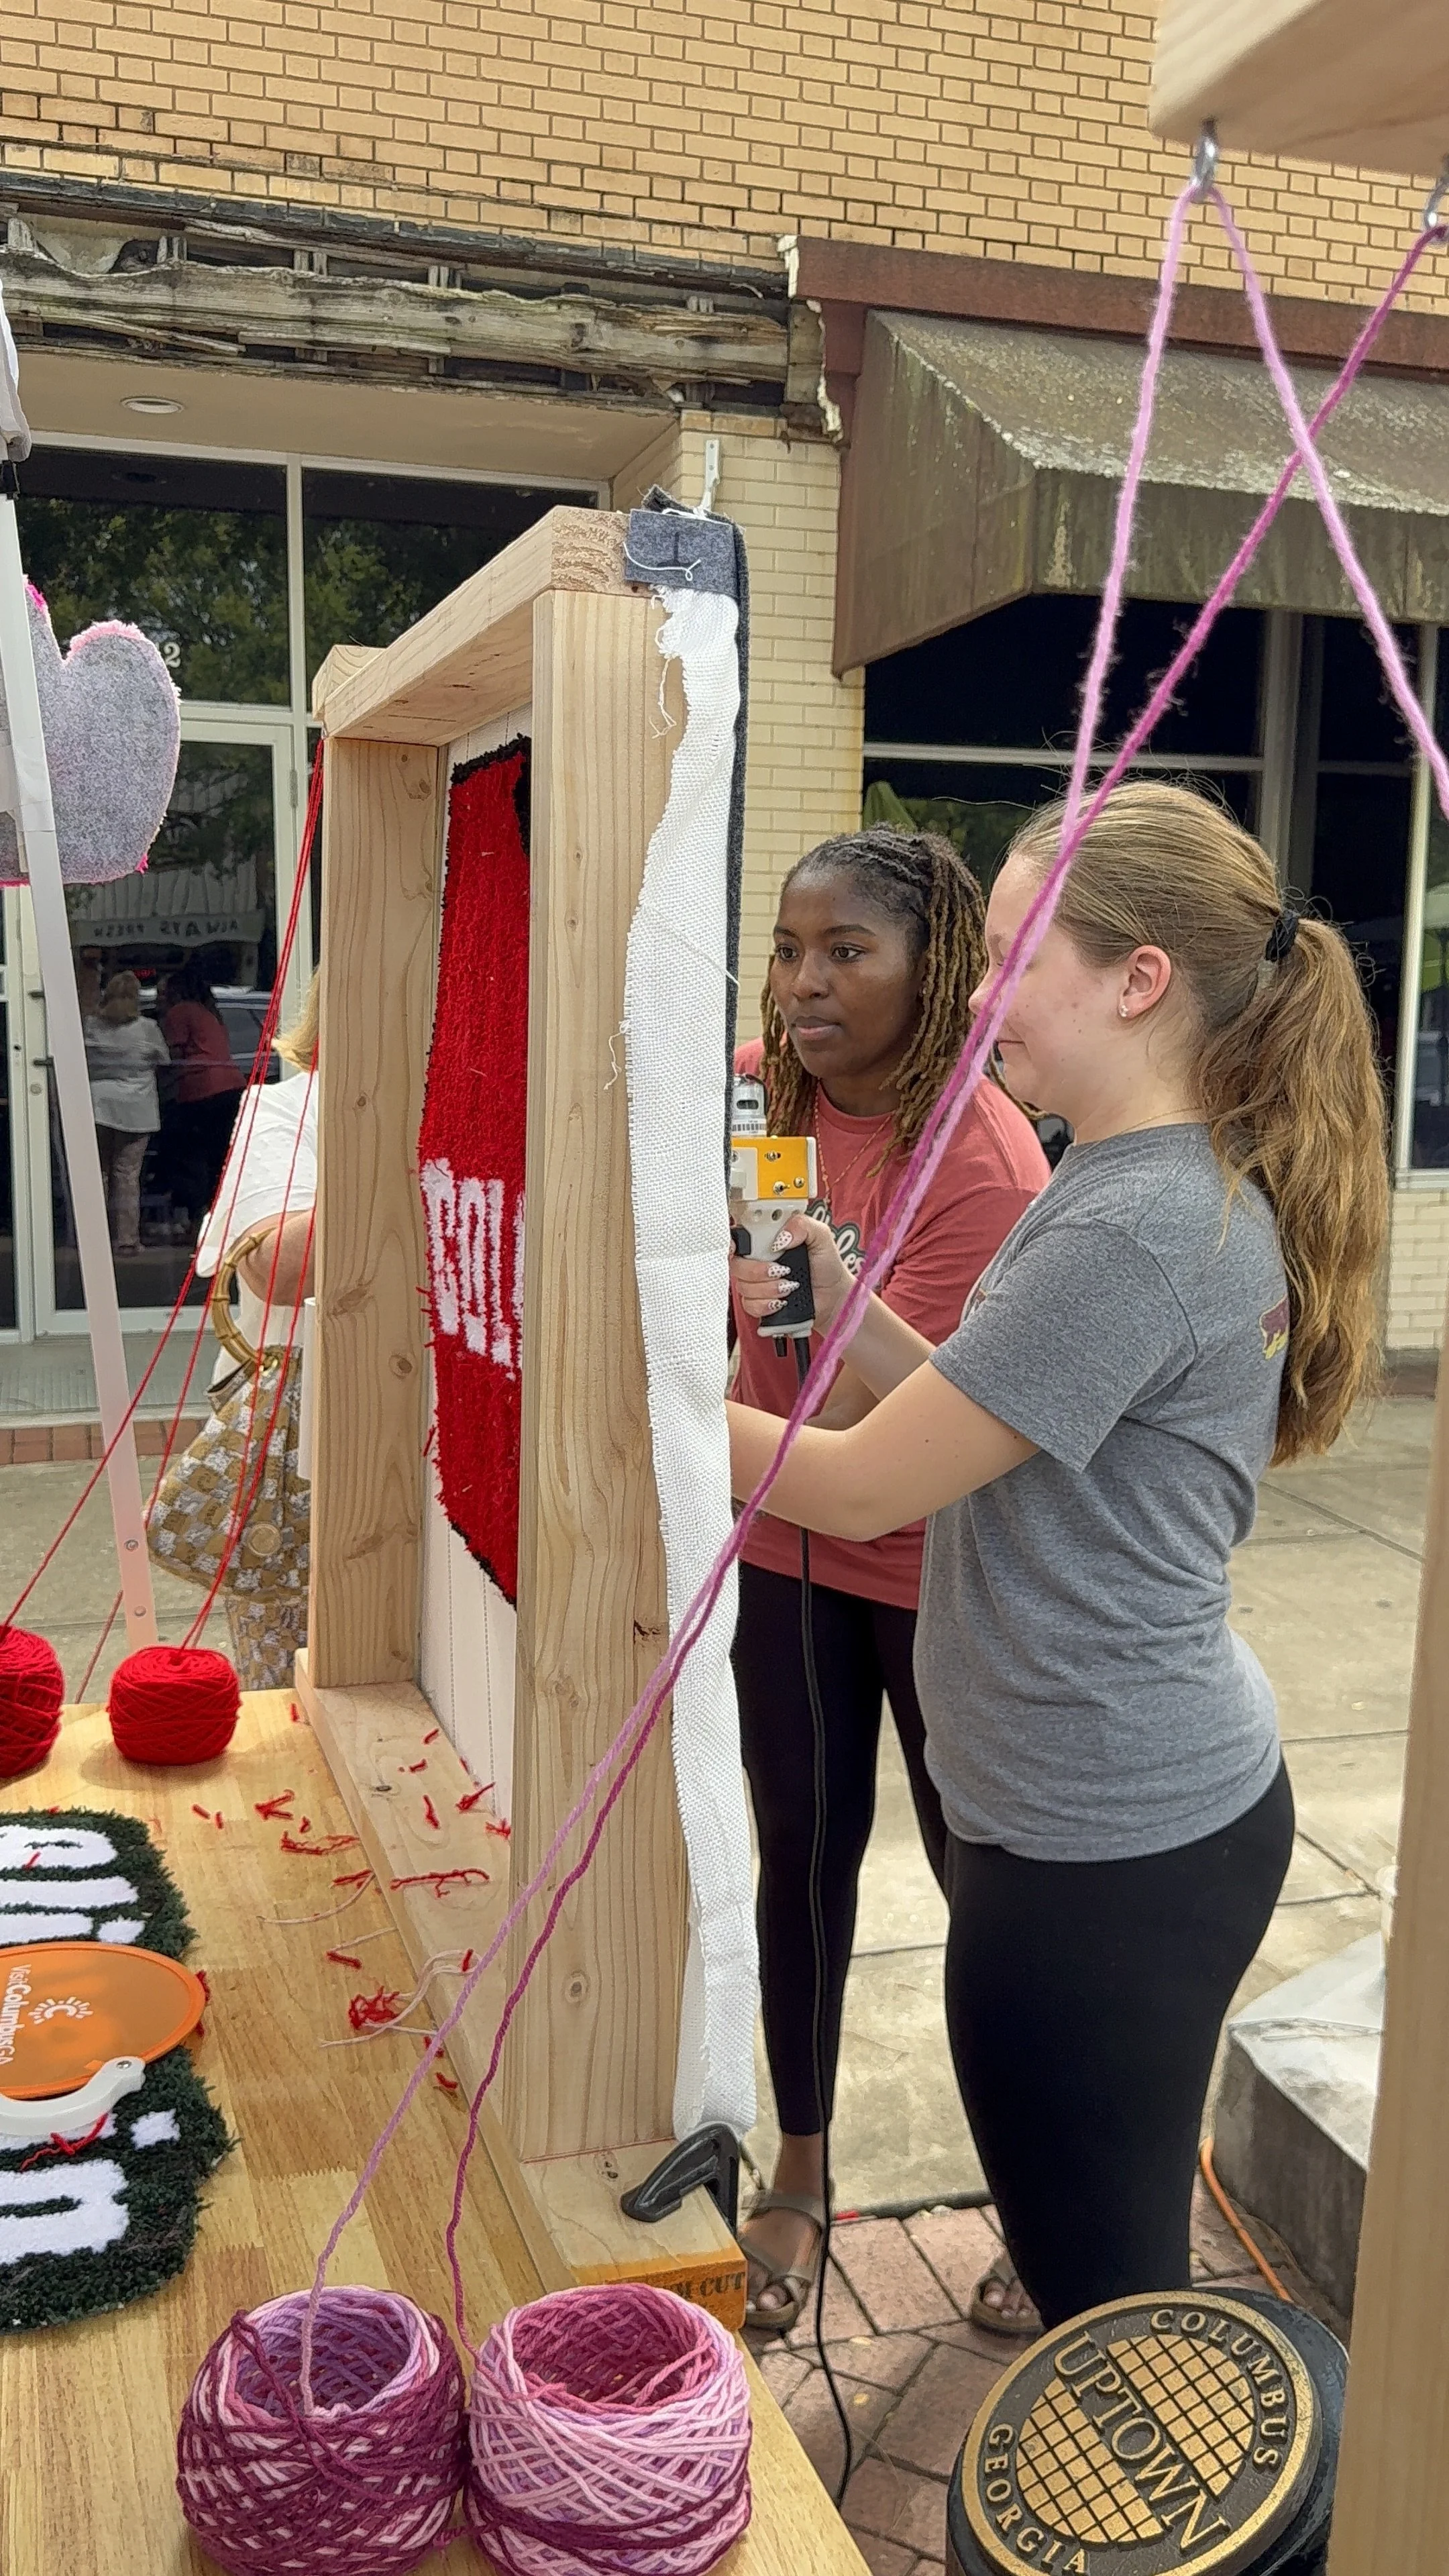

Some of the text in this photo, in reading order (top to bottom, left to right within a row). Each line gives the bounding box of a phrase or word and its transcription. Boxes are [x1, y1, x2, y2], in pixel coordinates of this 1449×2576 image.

[155, 642, 180, 668] 2
[700, 2271, 745, 2296] CUT
[1054, 2331, 1230, 2551] UPTOWN
[1150, 2308, 1289, 2469] COLUMBUS
[984, 2423, 1087, 2573] GEORGIA
